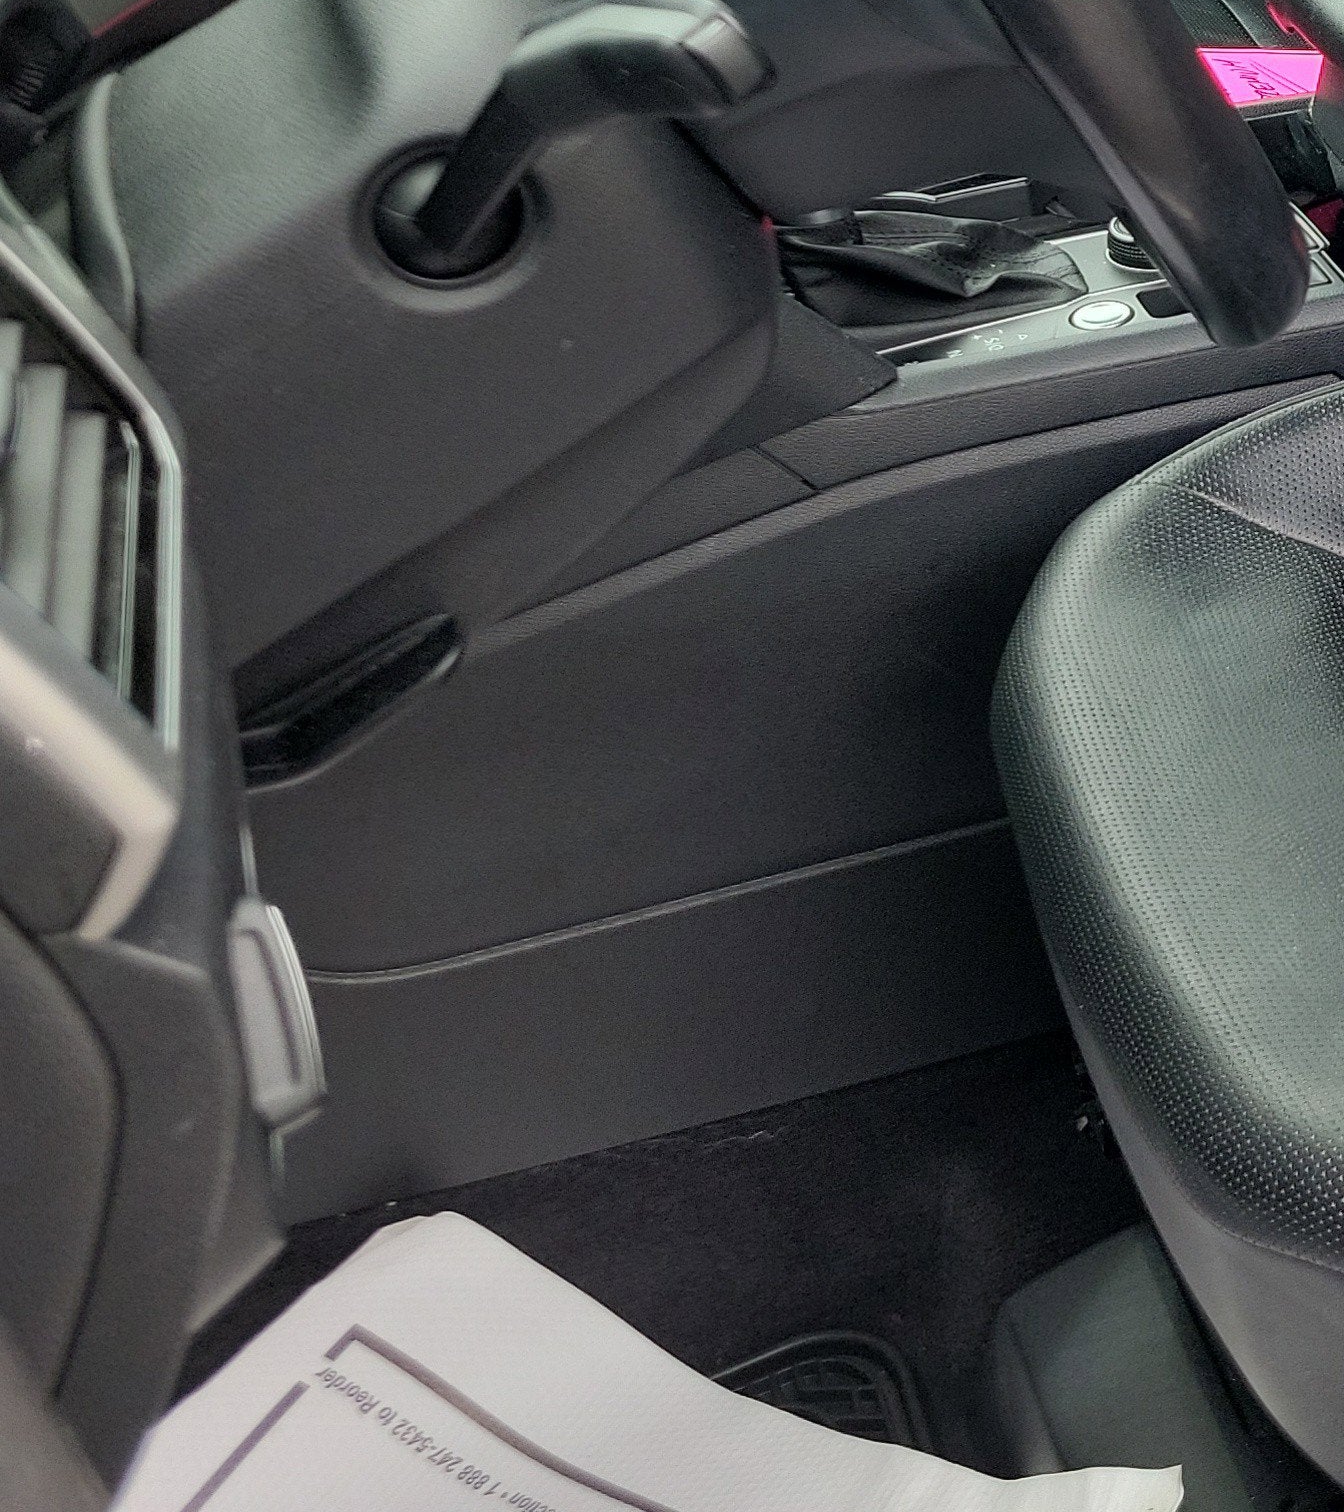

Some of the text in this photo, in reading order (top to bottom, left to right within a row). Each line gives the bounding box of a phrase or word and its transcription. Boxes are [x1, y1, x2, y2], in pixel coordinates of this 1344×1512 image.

[314, 1366, 377, 1415] Reorder
[377, 1405, 398, 1427] to
[391, 1416, 465, 1473] 247-5432
[456, 1464, 490, 1491] 888
[483, 1480, 502, 1496] 1
